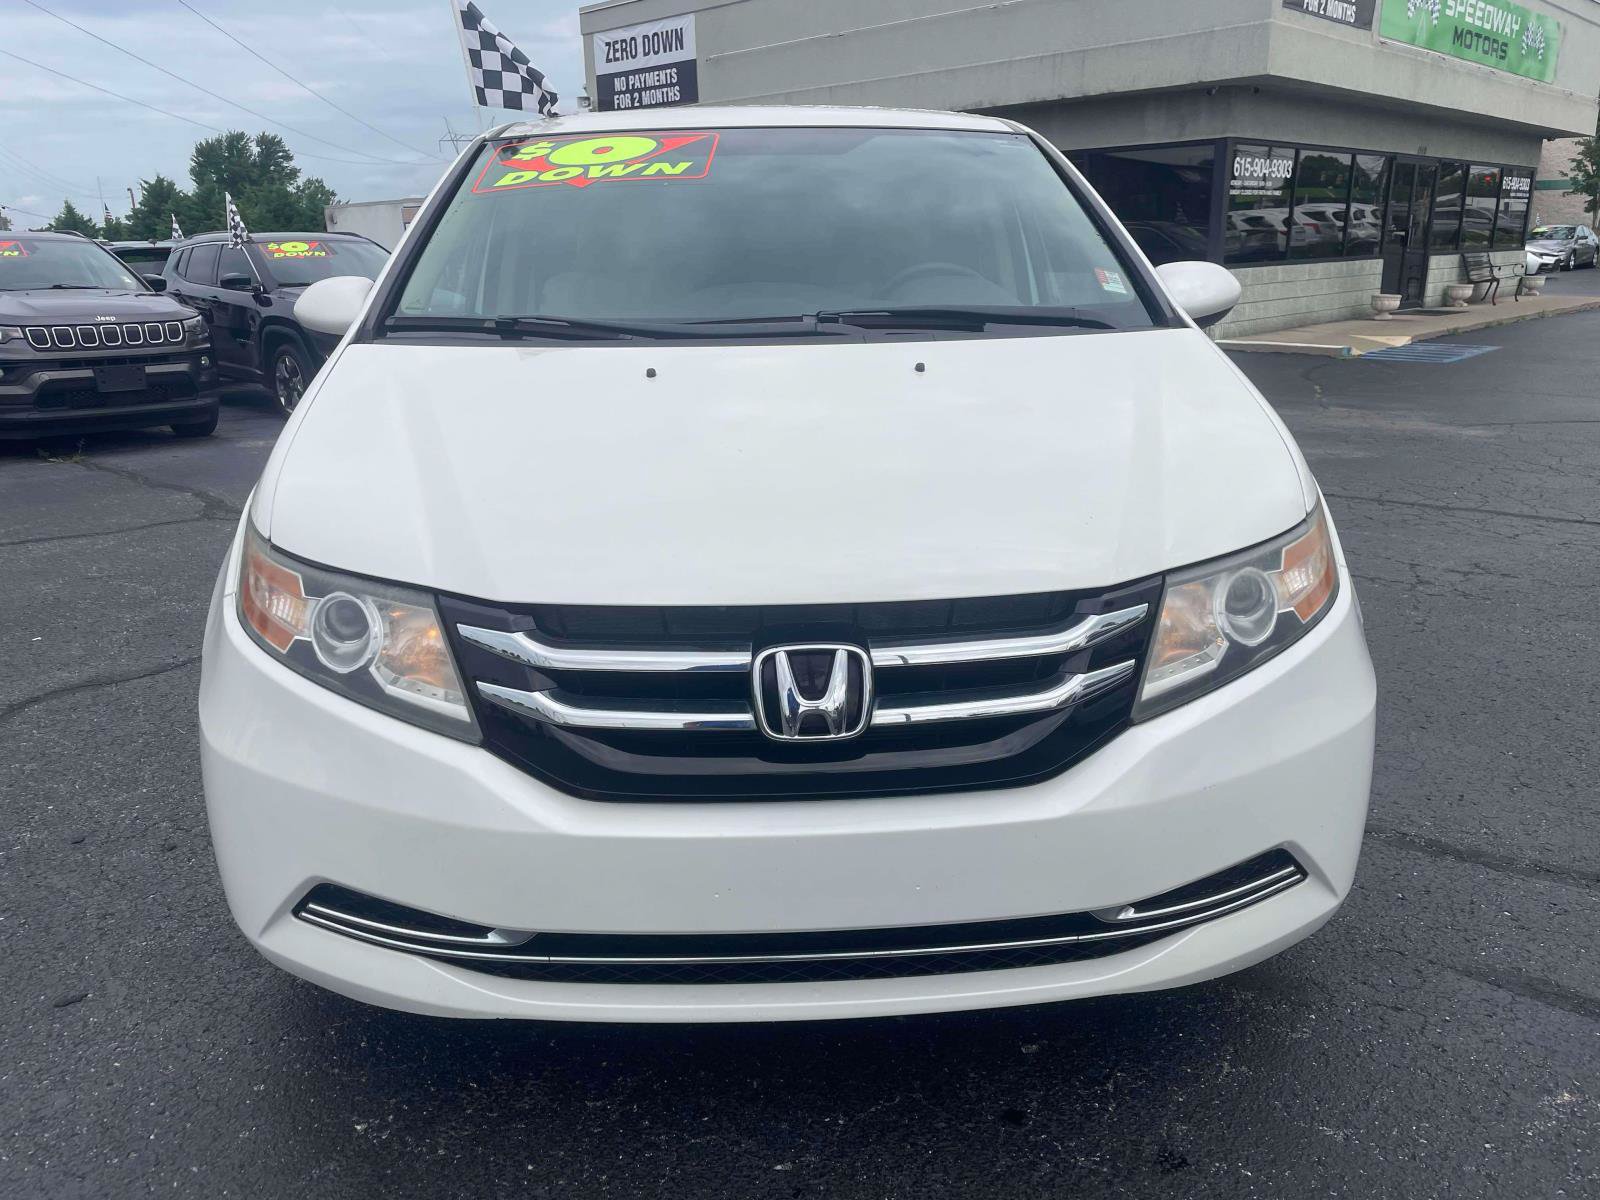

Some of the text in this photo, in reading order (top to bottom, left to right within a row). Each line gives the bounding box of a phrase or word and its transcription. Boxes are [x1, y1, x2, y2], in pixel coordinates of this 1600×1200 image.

[1325, 0, 1357, 23] MONTHS
[1445, 0, 1521, 39] SPEEDWAY
[605, 27, 684, 64] ZERO DOWN
[1452, 26, 1509, 61] MOTORS
[614, 67, 678, 92] NO PAYMENTS
[613, 85, 681, 110] FOR 2 MONTHS
[493, 161, 693, 187] DOWN
[1233, 156, 1293, 179] 615-904-9303
